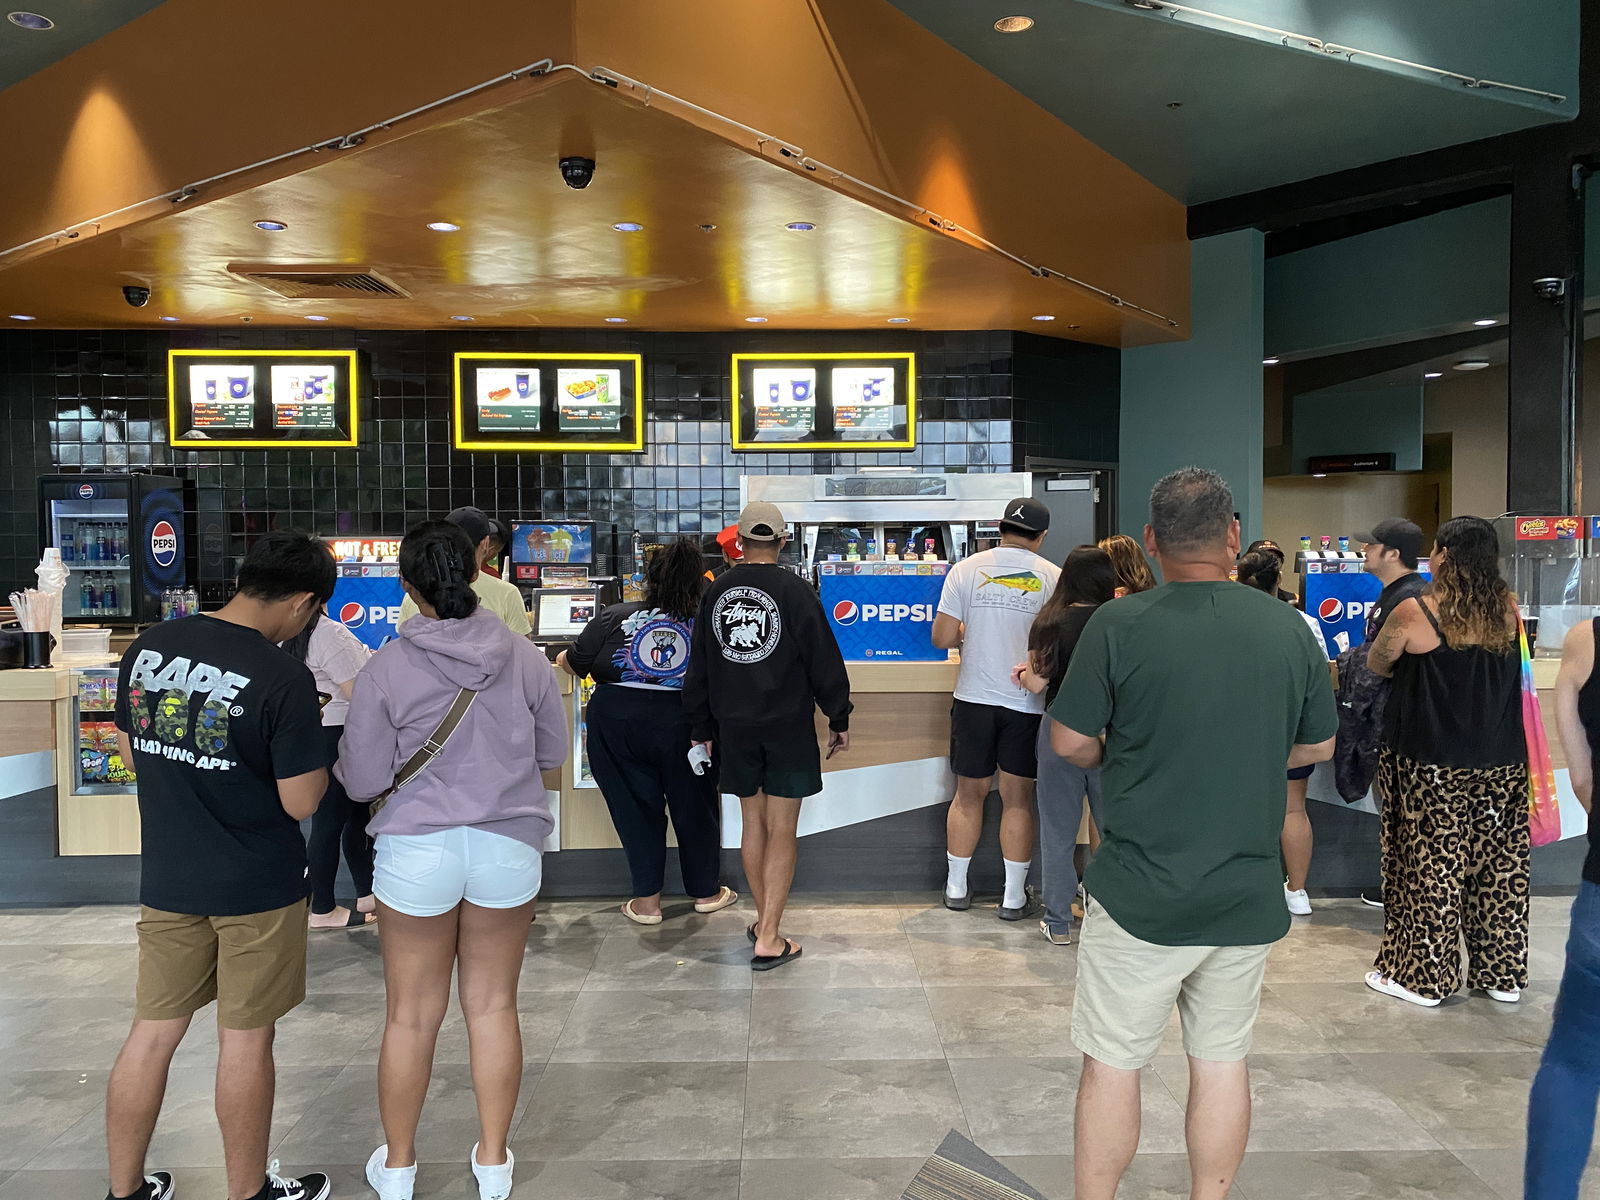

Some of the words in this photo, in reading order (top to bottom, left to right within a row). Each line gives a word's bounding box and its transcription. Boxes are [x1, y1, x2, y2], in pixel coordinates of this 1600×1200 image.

[154, 539, 175, 548] PEPSI
[334, 541, 361, 557] HOT
[362, 544, 371, 556] &
[976, 592, 1005, 602] SALTY
[1010, 596, 1038, 608] CREW
[862, 604, 933, 622] PEPSI
[129, 649, 251, 712] BAPE
[134, 736, 140, 750] A
